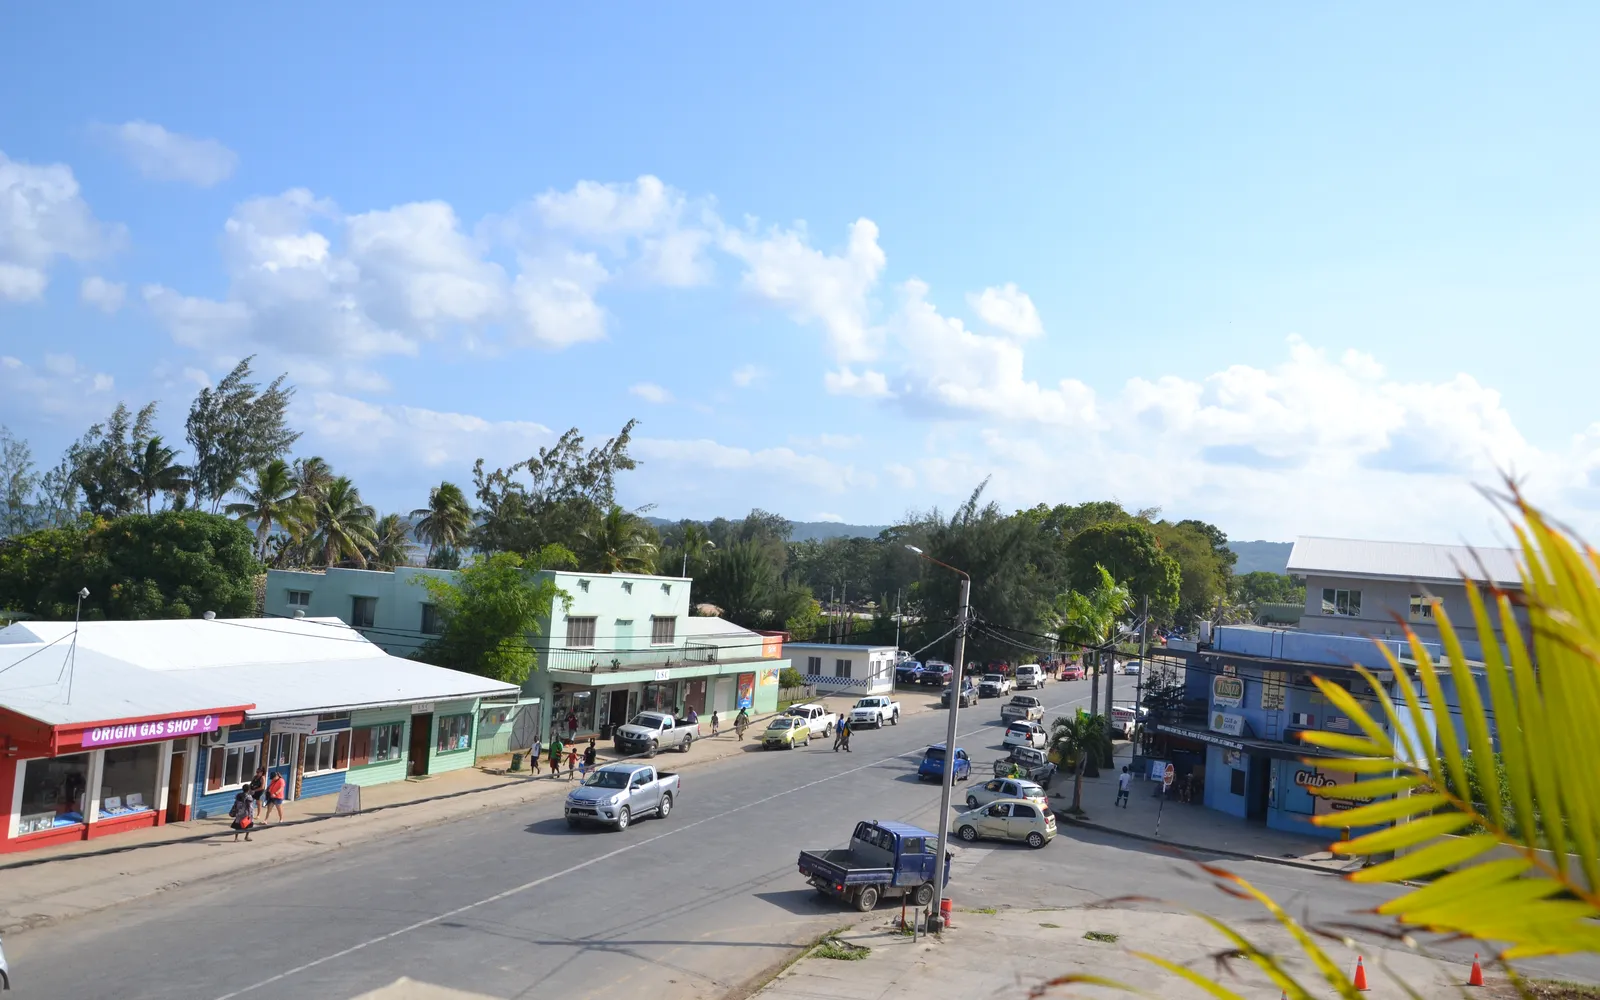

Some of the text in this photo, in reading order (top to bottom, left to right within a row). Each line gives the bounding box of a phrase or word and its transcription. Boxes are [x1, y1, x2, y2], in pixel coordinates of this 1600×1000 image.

[91, 718, 199, 742] ORIGIN GAS SHOP
[1296, 771, 1325, 788] Club
